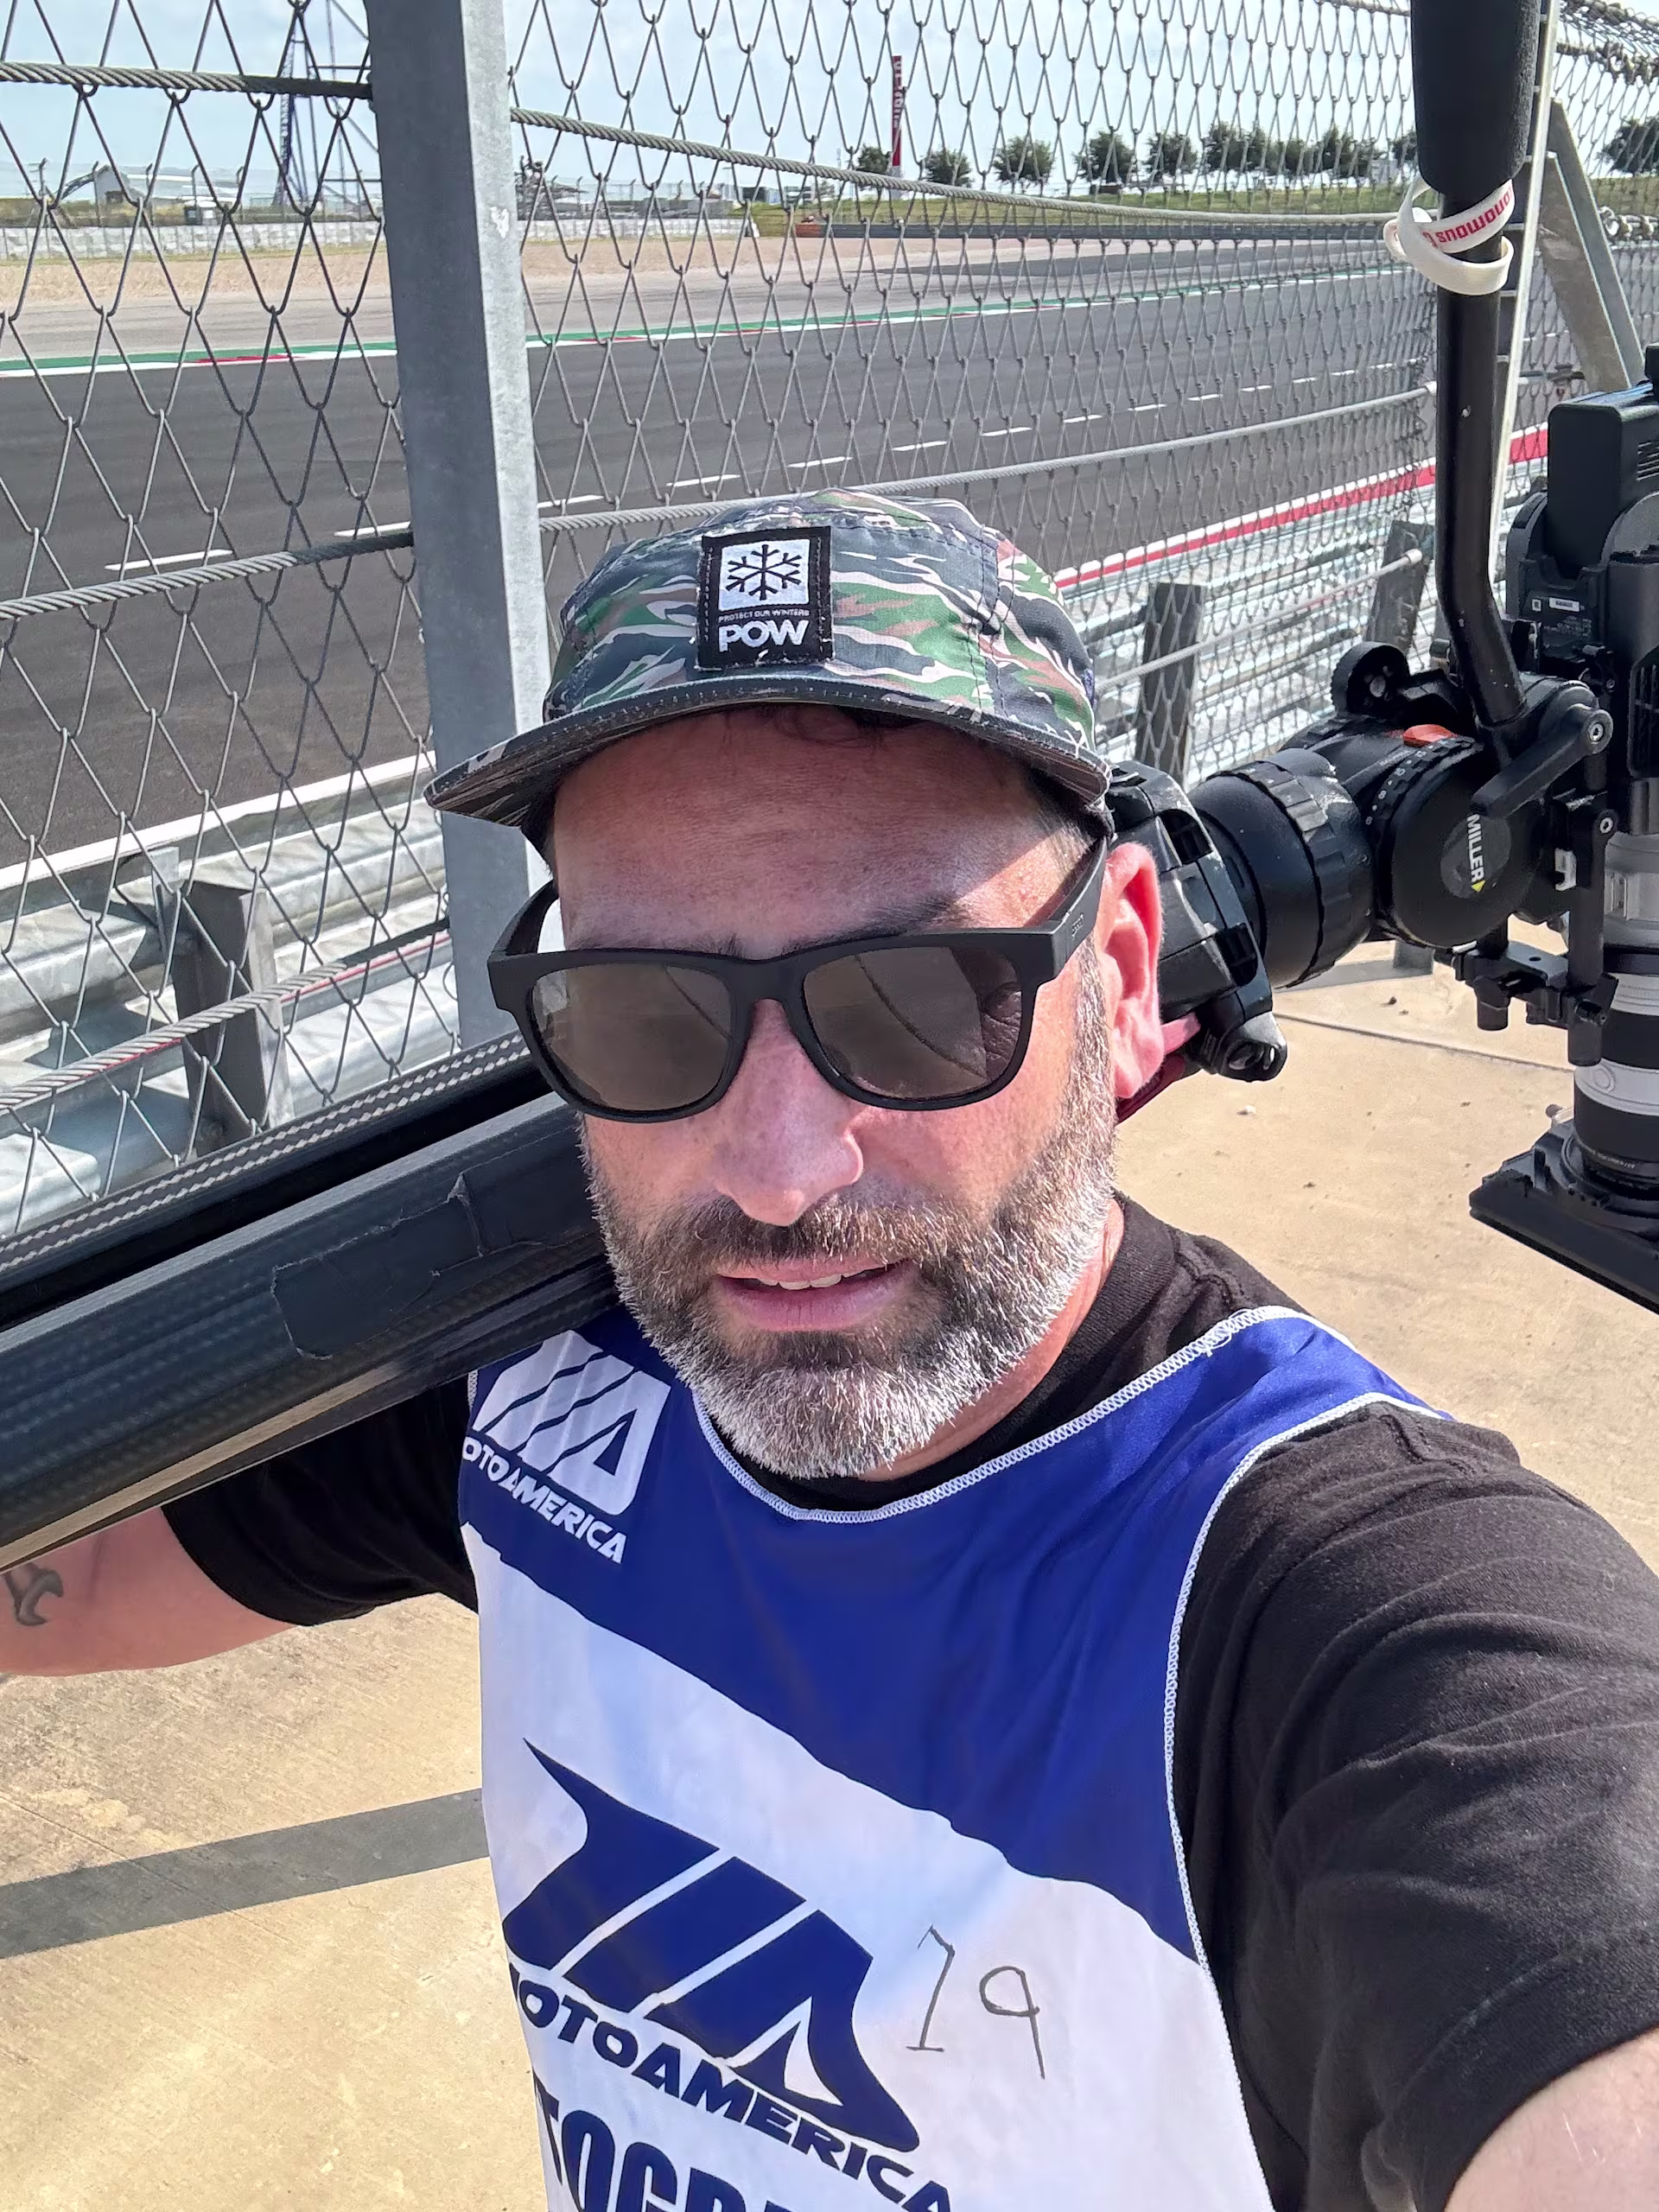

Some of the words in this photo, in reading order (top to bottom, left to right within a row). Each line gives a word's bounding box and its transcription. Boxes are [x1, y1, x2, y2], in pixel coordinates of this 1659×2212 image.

[1435, 185, 1513, 243] onomous
[718, 611, 753, 624] PROTECT
[772, 608, 810, 617] WINTERS
[718, 619, 810, 652] POW
[1466, 814, 1485, 882] MILLER
